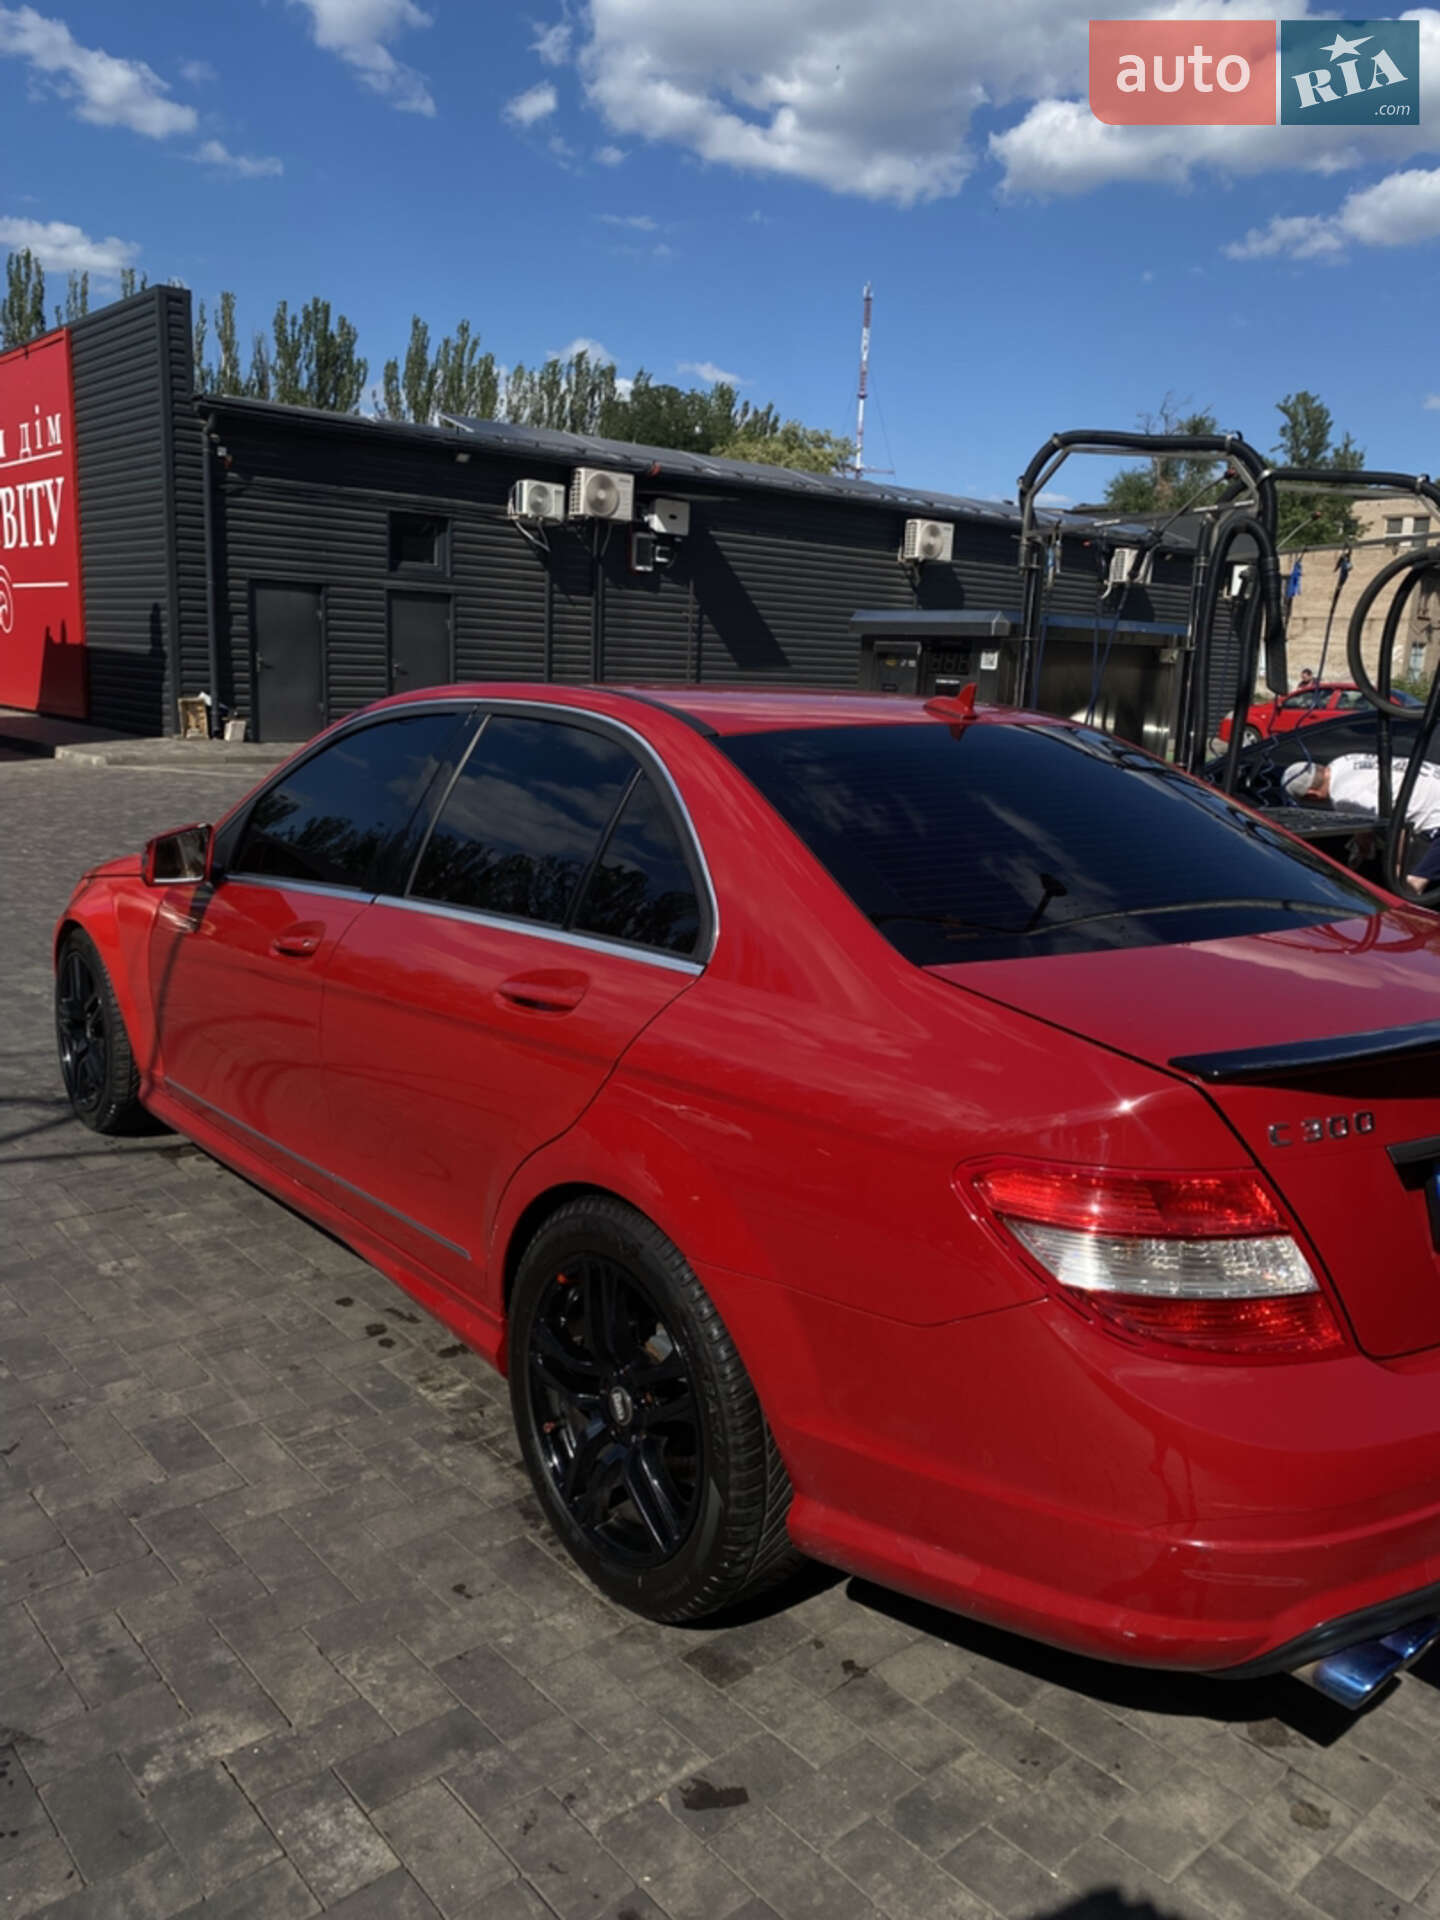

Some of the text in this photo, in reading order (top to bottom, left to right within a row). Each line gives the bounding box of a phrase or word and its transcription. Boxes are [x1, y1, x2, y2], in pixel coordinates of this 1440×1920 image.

[19, 404, 62, 459] дім
[1268, 1111, 1375, 1146] C 300
